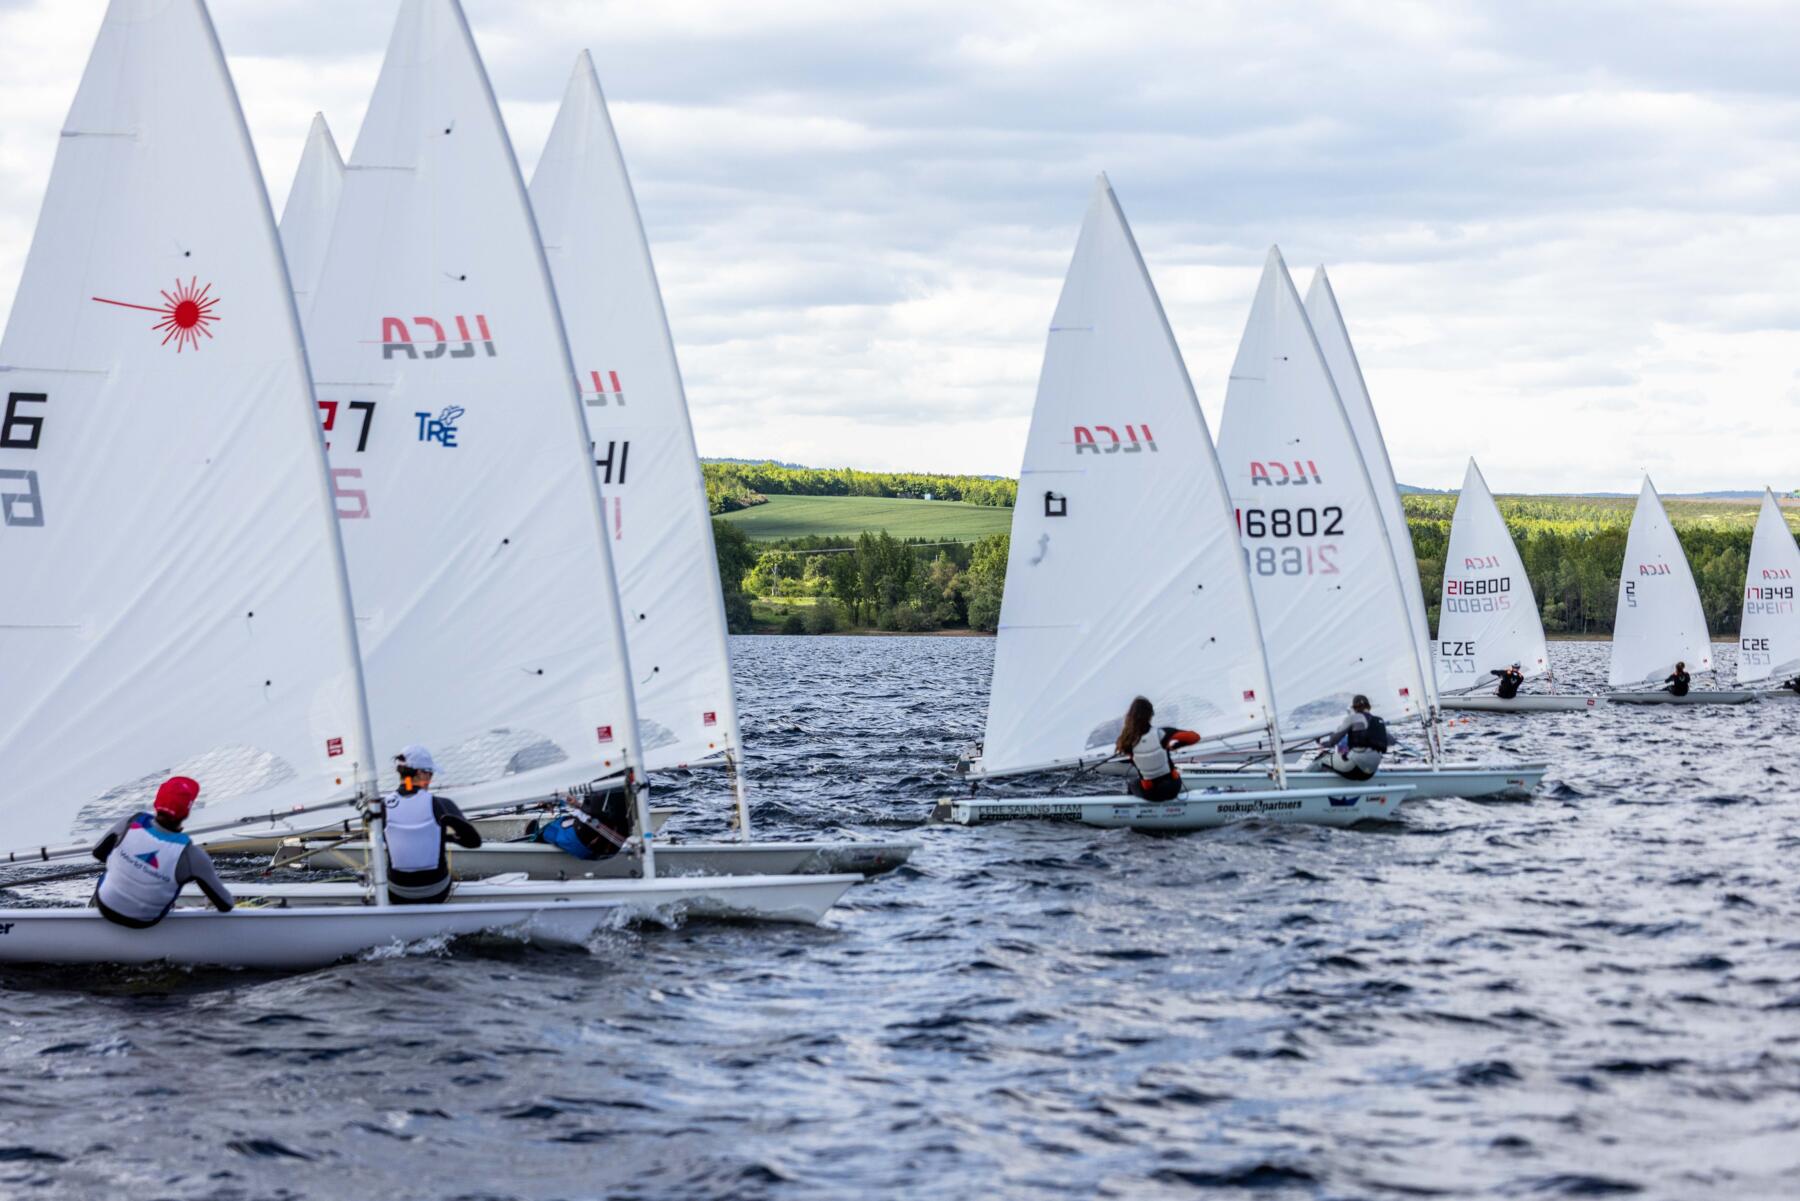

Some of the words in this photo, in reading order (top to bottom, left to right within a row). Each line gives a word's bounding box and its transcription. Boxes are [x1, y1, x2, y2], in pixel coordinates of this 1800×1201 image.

[0, 392, 47, 449] 6
[414, 411, 458, 448] TRE
[1447, 577, 1510, 595] 216800
[1747, 587, 1793, 600] 171349
[1442, 642, 1475, 656] CZE
